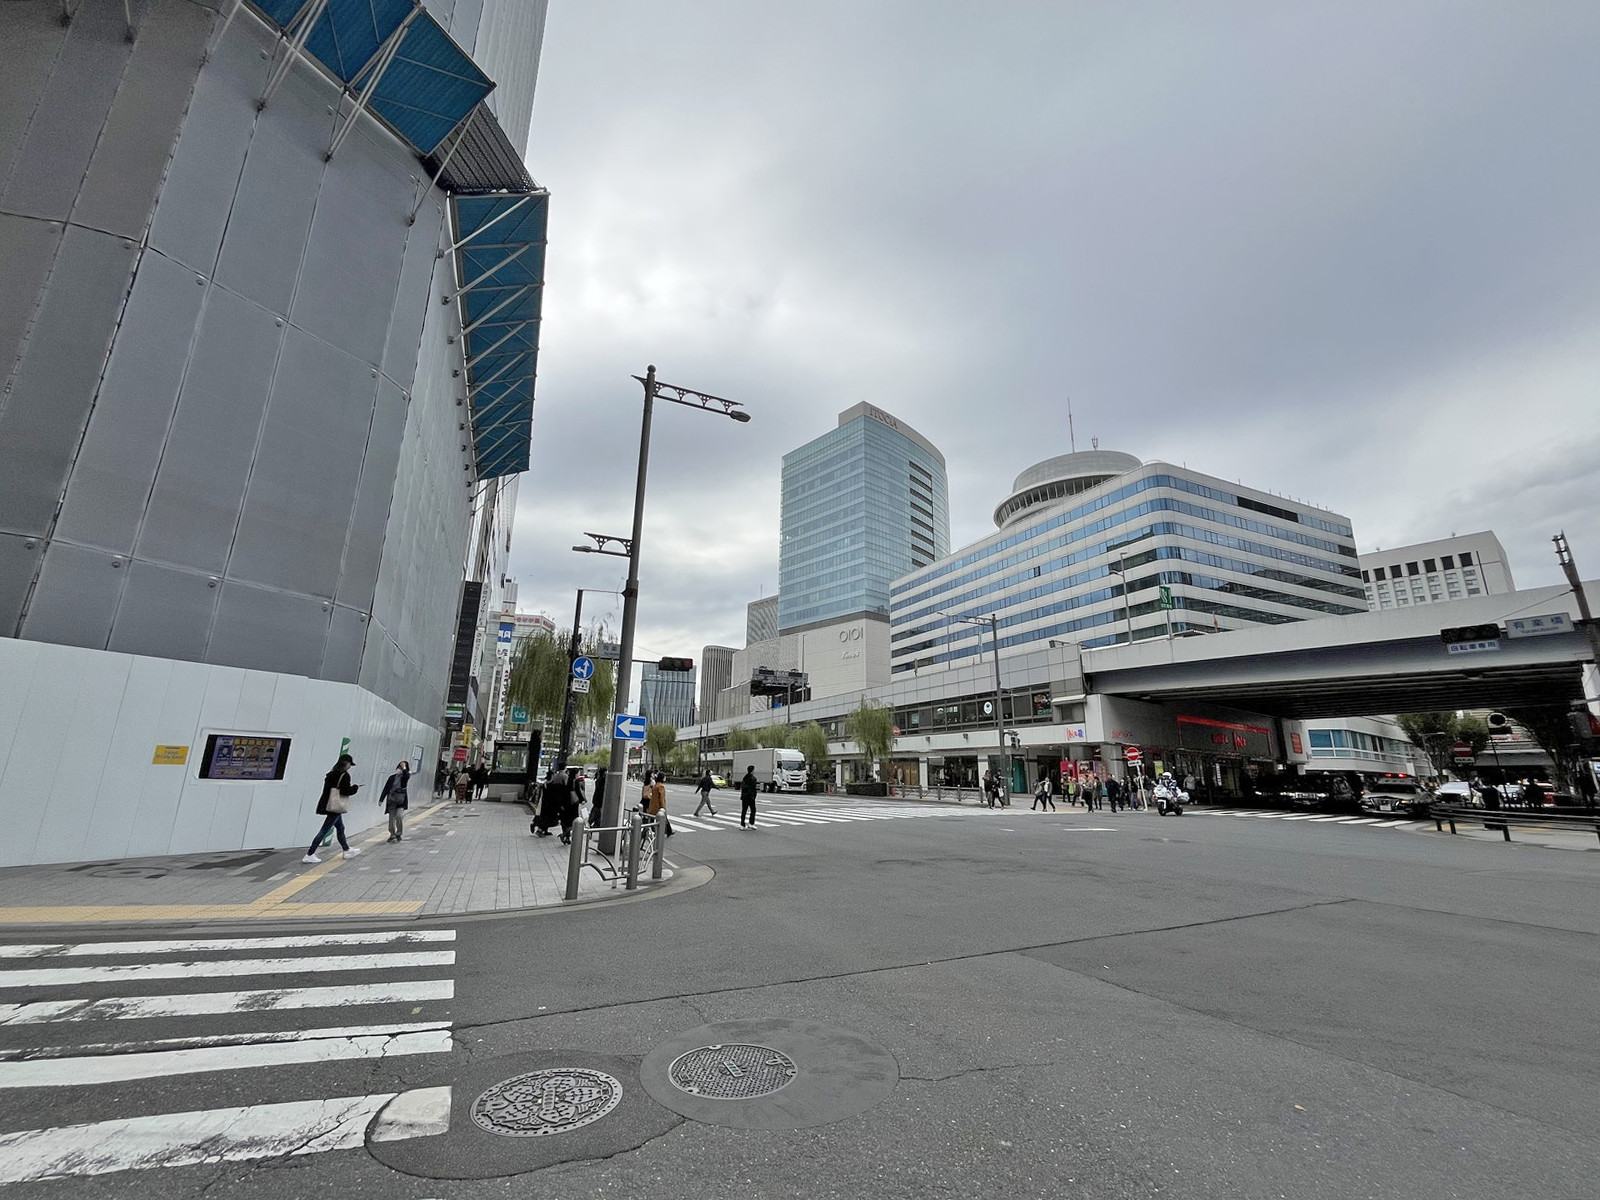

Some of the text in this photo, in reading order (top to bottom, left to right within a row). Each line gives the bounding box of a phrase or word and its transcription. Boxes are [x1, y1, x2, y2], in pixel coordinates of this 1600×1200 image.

[1451, 641, 1496, 651] 自転車専用
